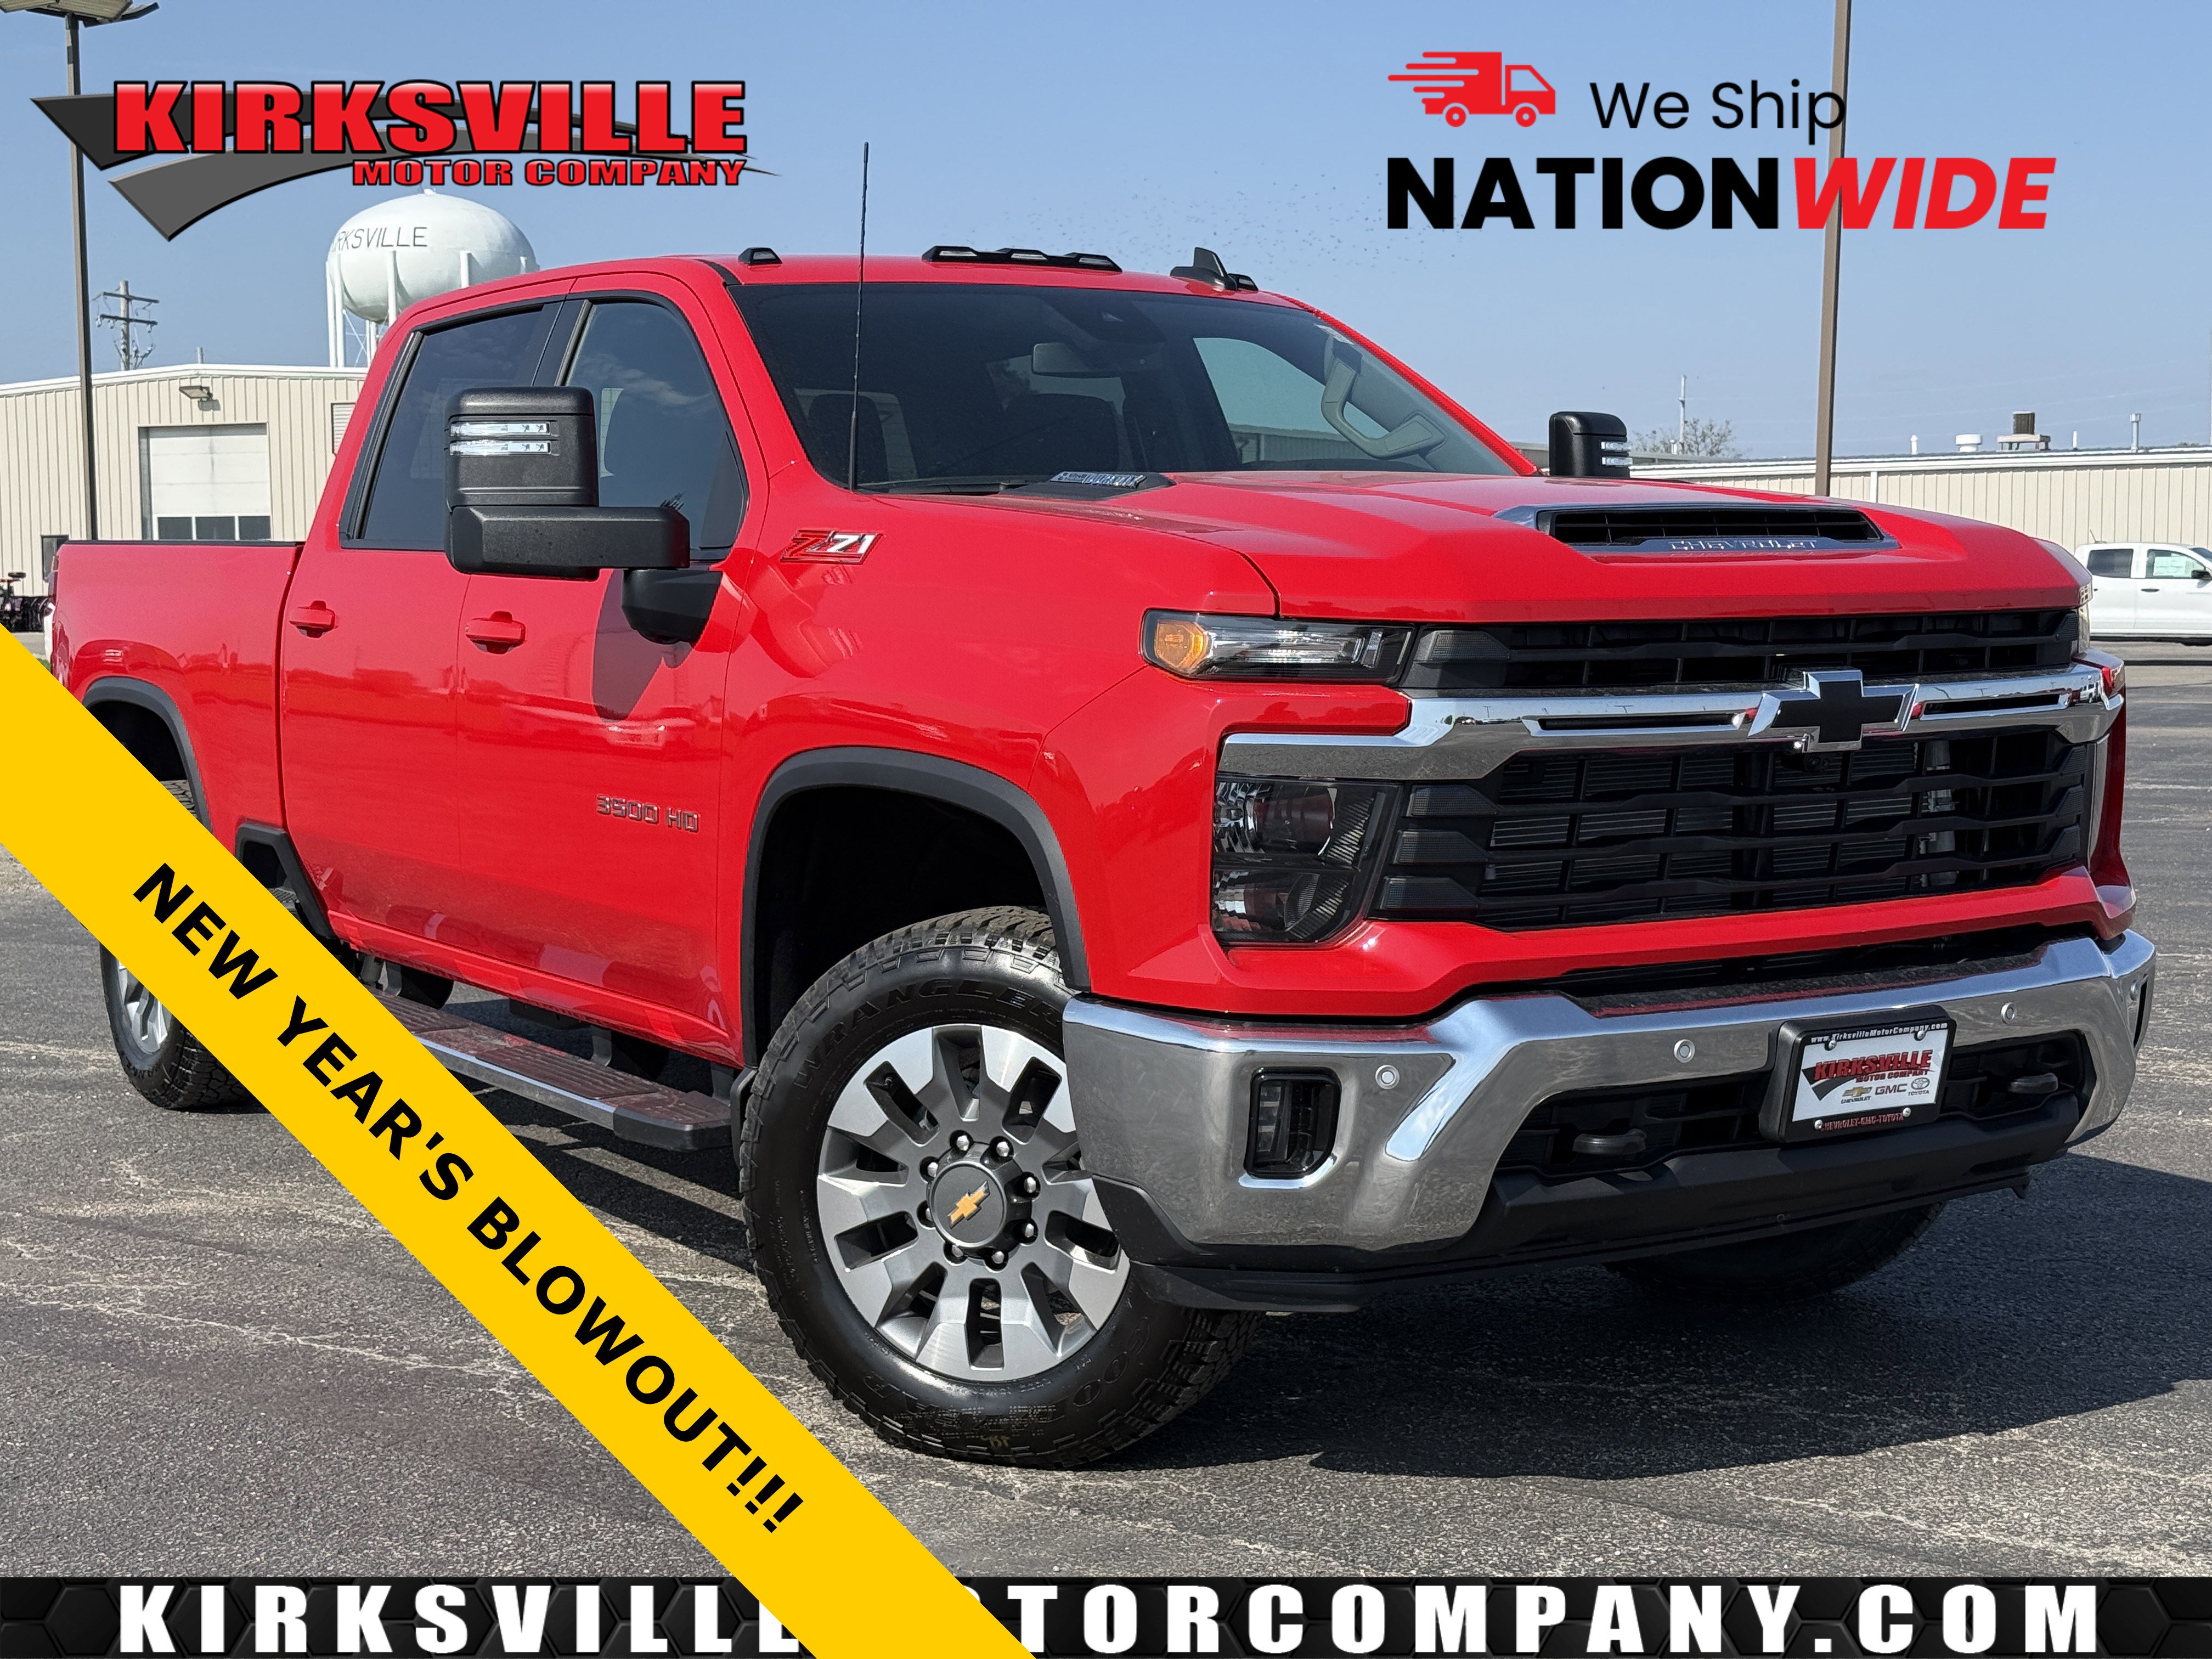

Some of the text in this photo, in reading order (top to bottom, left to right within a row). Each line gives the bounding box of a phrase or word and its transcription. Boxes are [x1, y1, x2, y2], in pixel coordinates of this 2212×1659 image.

[596, 794, 699, 833] 3500 HD
[1814, 1050, 1933, 1080] KIRKSVILLE
[1875, 1083, 1908, 1095] GMC
[1821, 1113, 1904, 1132] HEVROLET-GMC-TOYOTA
